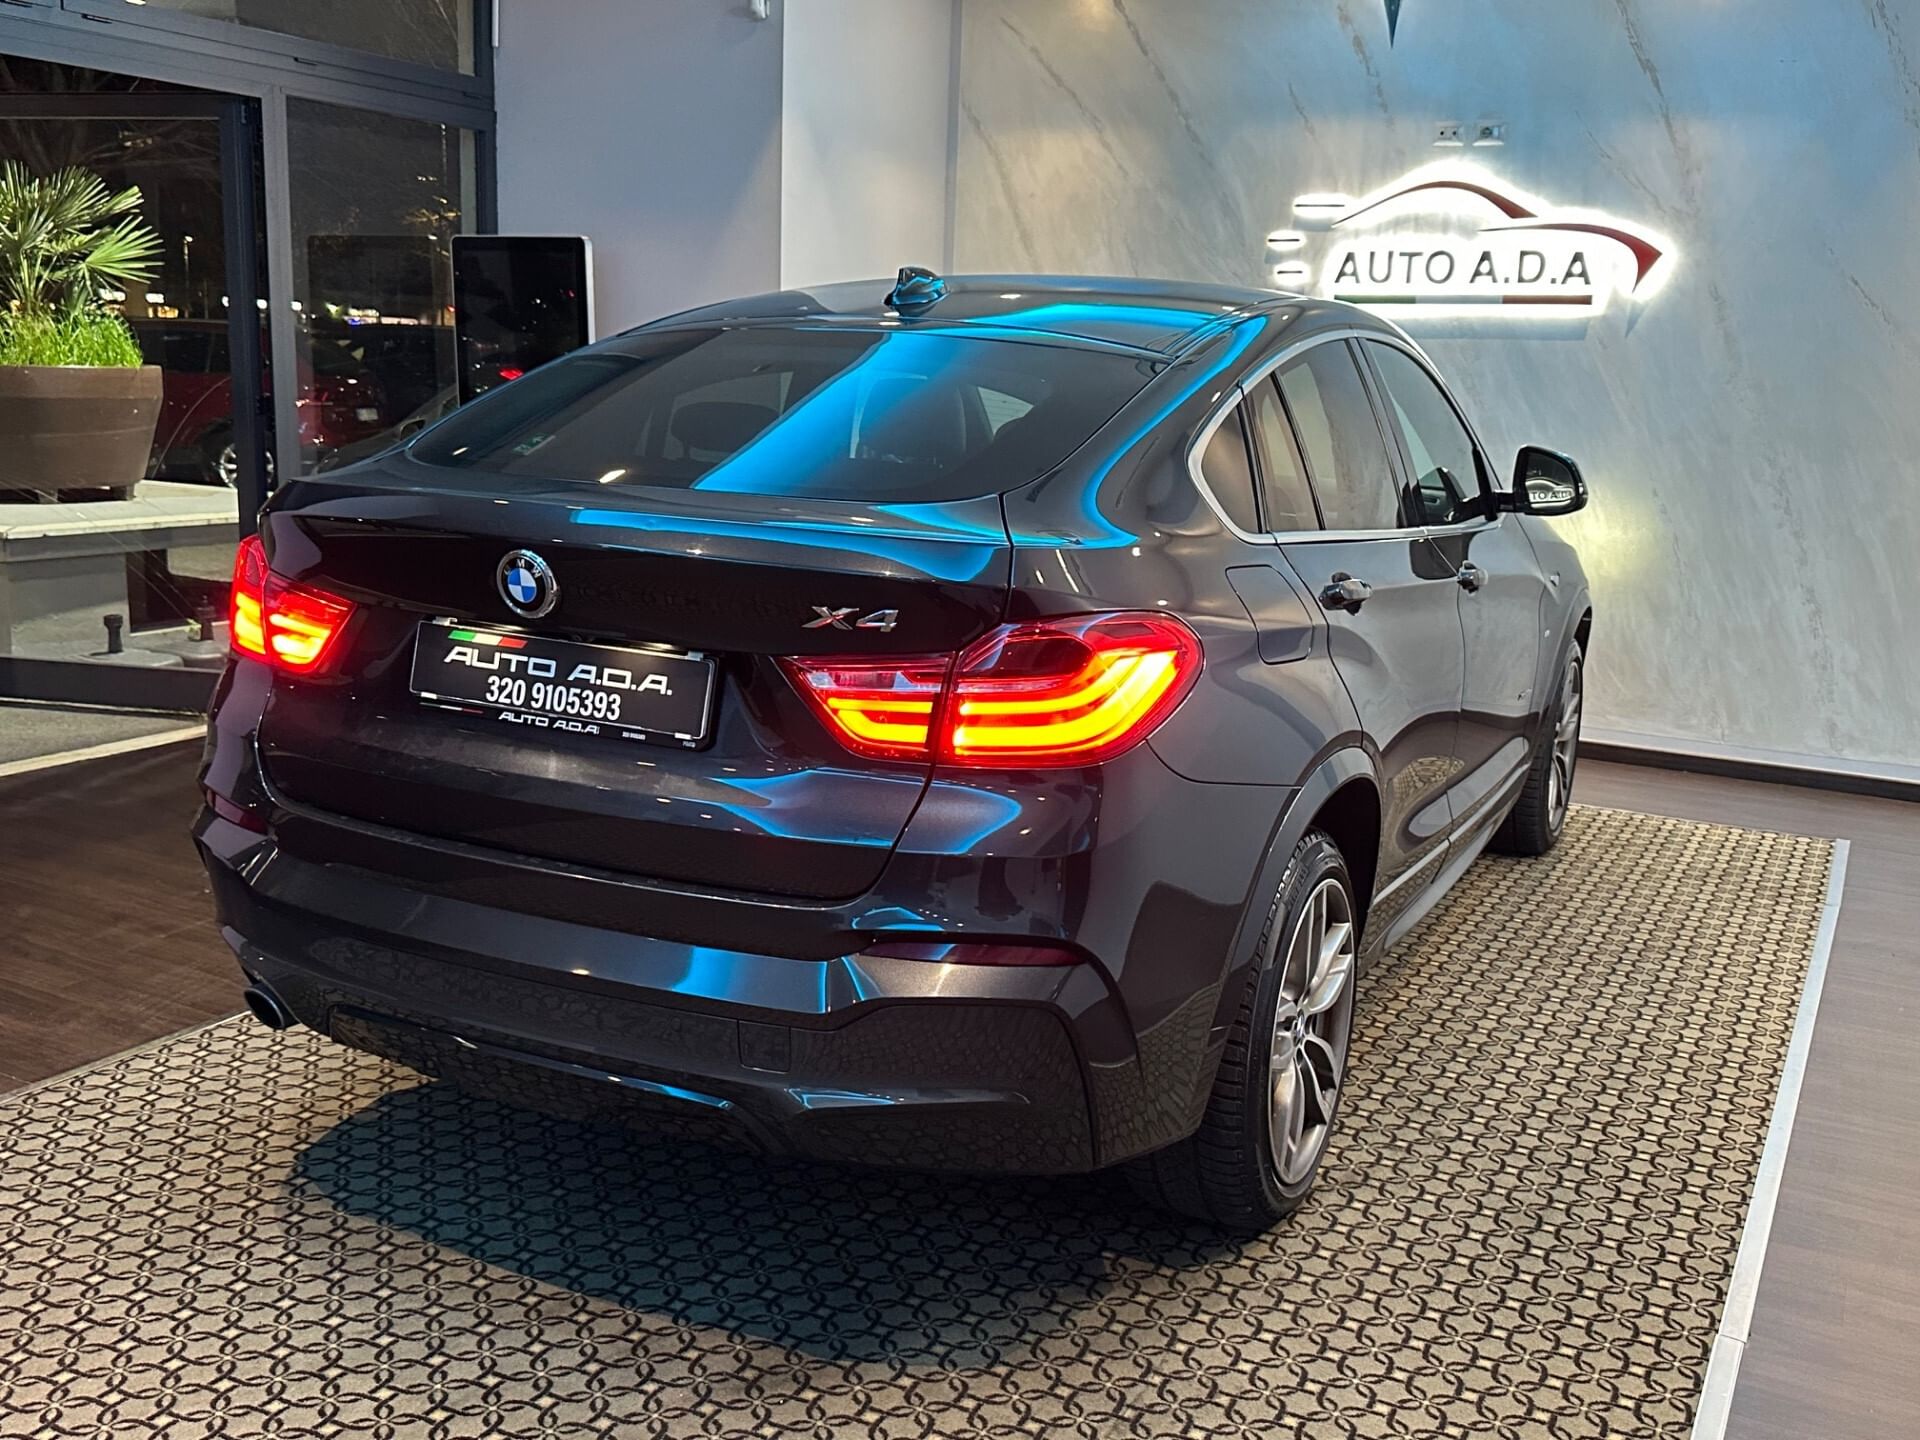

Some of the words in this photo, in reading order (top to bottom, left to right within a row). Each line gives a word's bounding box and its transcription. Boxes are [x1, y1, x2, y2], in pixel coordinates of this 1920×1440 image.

[1334, 250, 1455, 284] AUTO
[1469, 250, 1591, 285] A.D.A
[801, 606, 899, 632] X4
[443, 645, 557, 679] AUTO
[567, 663, 673, 696] A.D.A.
[485, 675, 527, 706] 320
[530, 682, 621, 721] 9105393
[498, 711, 549, 727] AUTO
